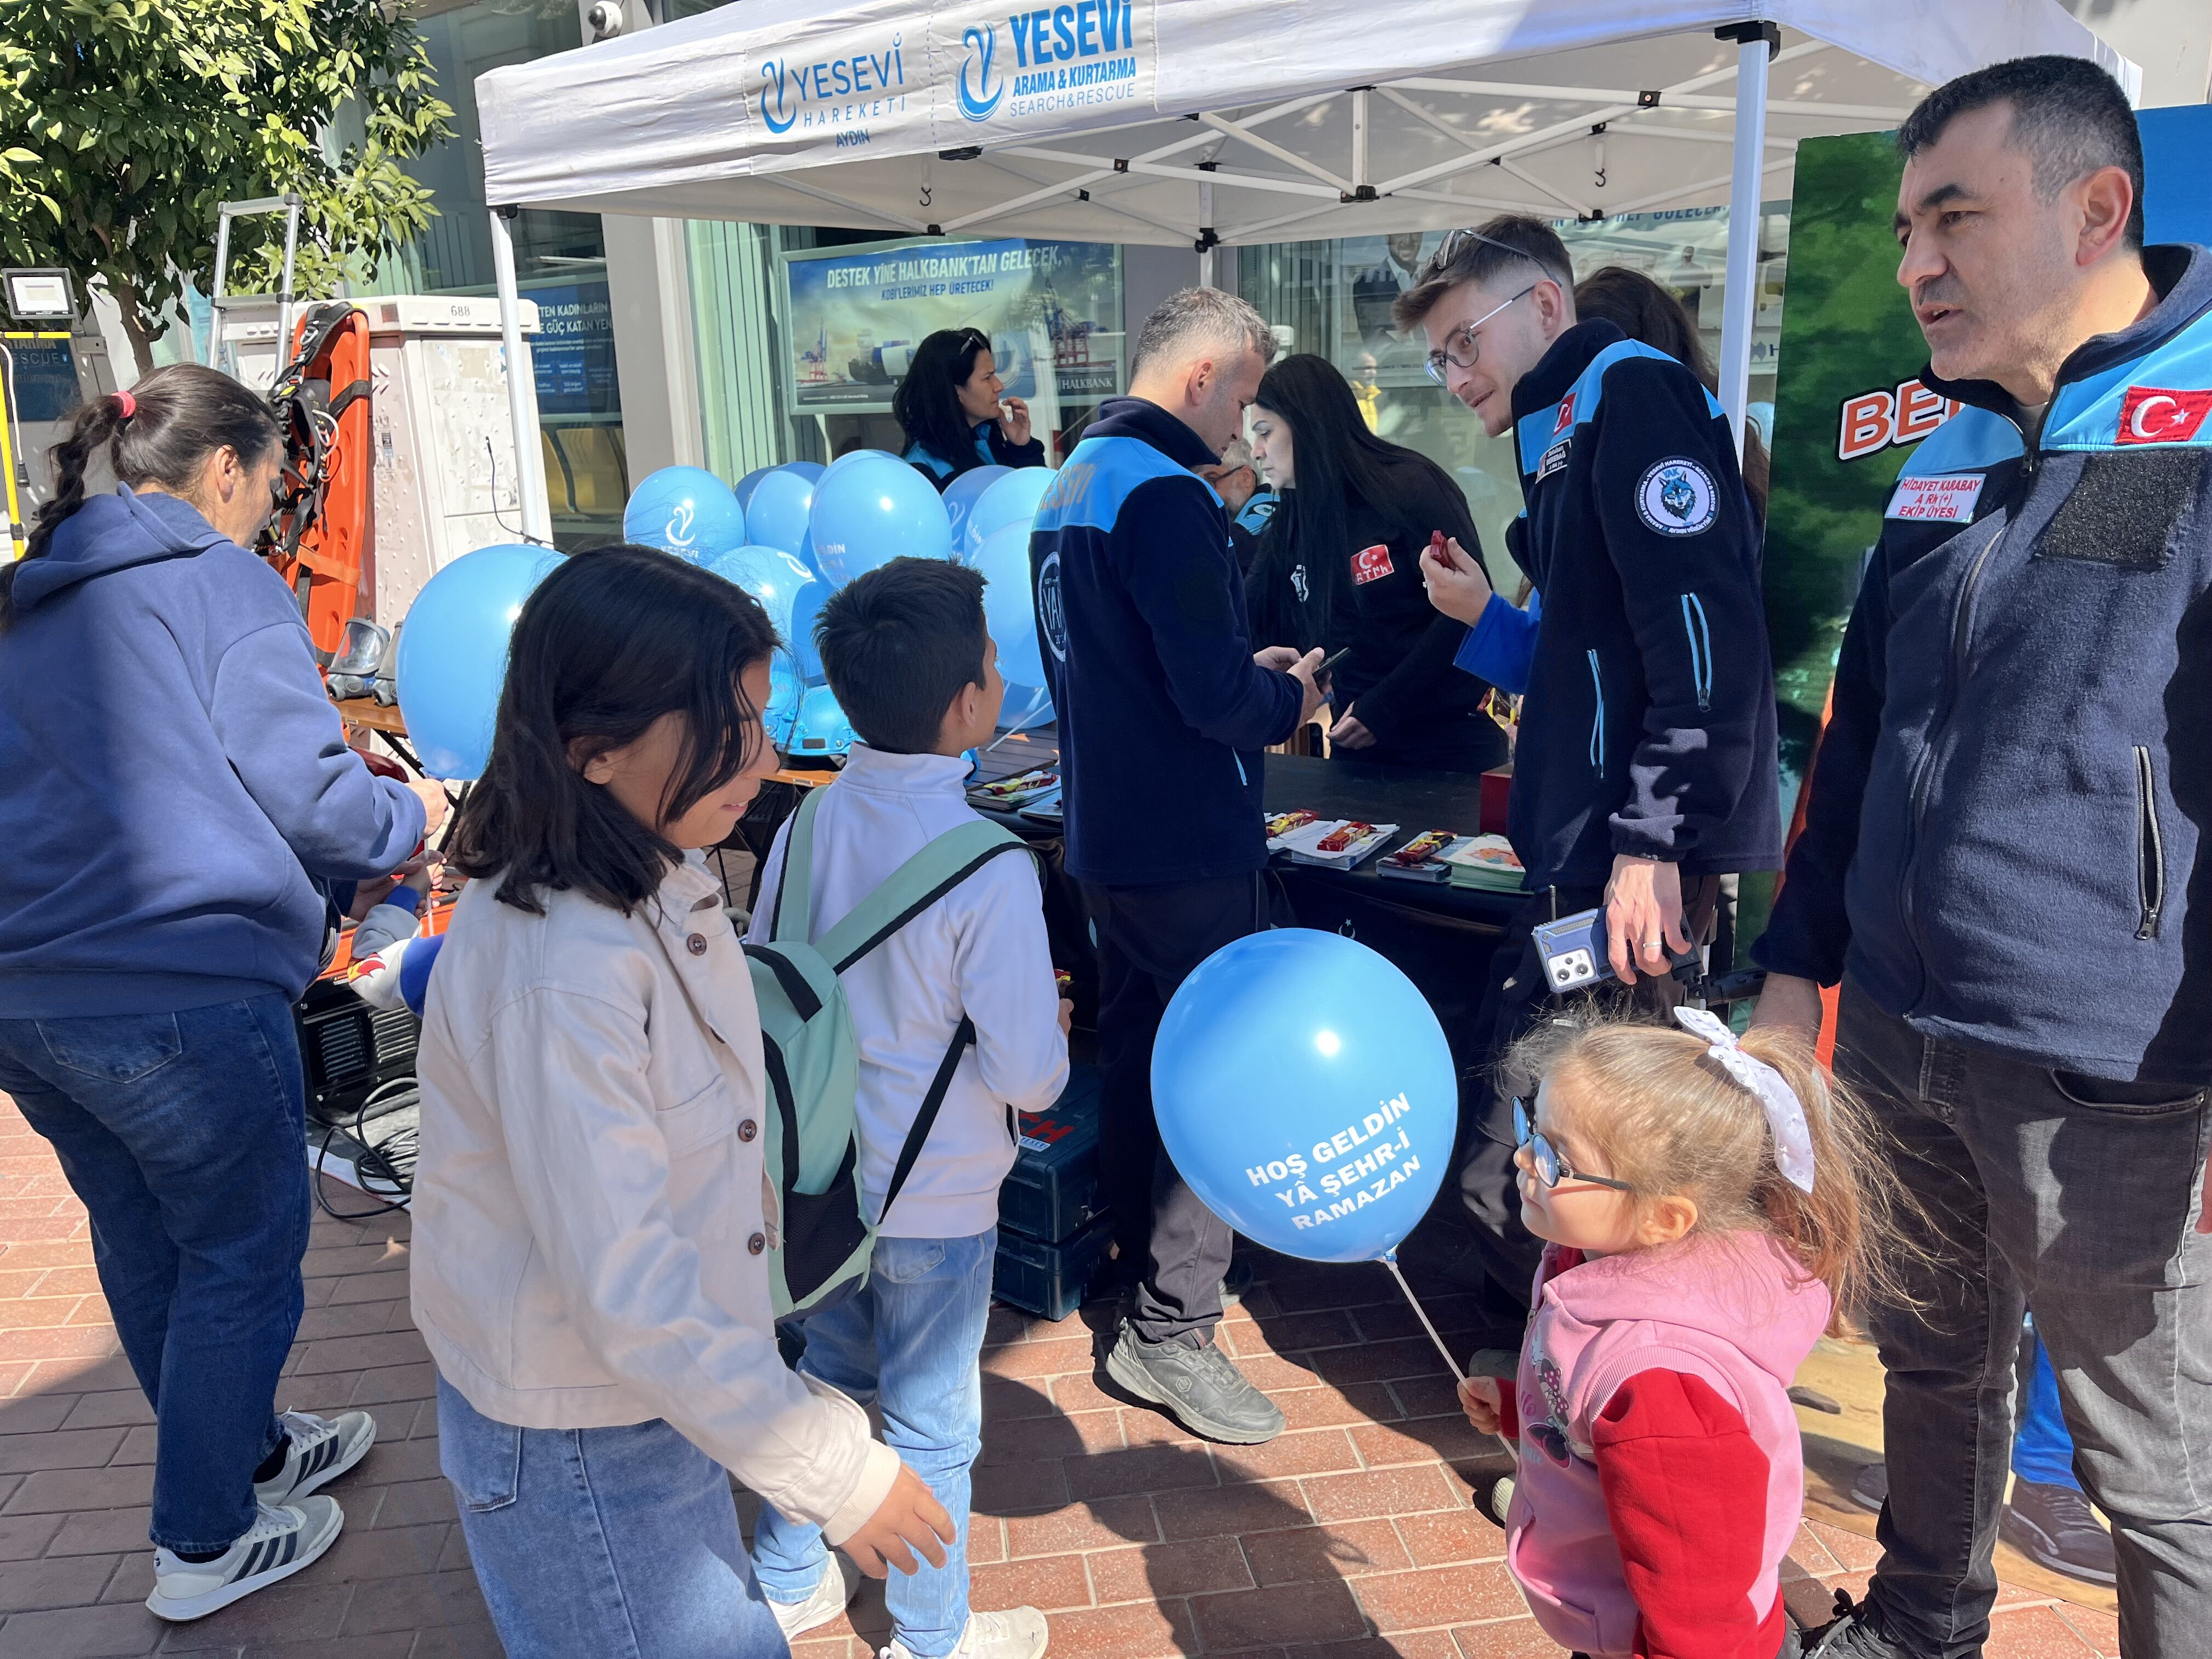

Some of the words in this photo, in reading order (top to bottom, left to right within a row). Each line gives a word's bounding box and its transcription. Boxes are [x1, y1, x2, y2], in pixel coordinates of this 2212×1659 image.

[1009, 0, 1133, 67] YESEVİ
[790, 31, 904, 101] YESEVİ
[1013, 70, 1056, 97] ARAMA
[1058, 68, 1067, 89] &
[1070, 57, 1136, 88] KURTARMA
[804, 92, 905, 127] HAREKETİ
[1010, 82, 1135, 117] SEARCH&RESCUE
[837, 128, 871, 148] AYDIN
[827, 264, 870, 289] DESTEK
[874, 262, 896, 284] YİNE
[899, 253, 997, 279] HALKBANK'TAN
[1000, 245, 1063, 272] GELECEK,
[882, 284, 927, 301] KOBİ'LERİMİZ
[930, 284, 946, 297] HEP
[949, 279, 994, 295] ÜRETECEK!
[451, 305, 470, 317] 688
[557, 302, 608, 317] KADINLARIN
[546, 318, 566, 336] GÜÇ
[567, 319, 595, 333] KATAN
[1062, 377, 1113, 390] HALKBANK
[1901, 478, 1939, 492] HİDAYET
[1938, 479, 1982, 492] KARABAY
[1915, 493, 1924, 504] A
[1898, 505, 1925, 517] EKİP
[1926, 504, 1959, 518] ÜYESİ
[1245, 1154, 1307, 1187] HOŞ
[1312, 1092, 1410, 1163] GELDİN
[1274, 1180, 1319, 1207] YÂ
[1320, 1126, 1410, 1197] ŞEHR-İ
[1291, 1154, 1420, 1229] RAMAZAN
